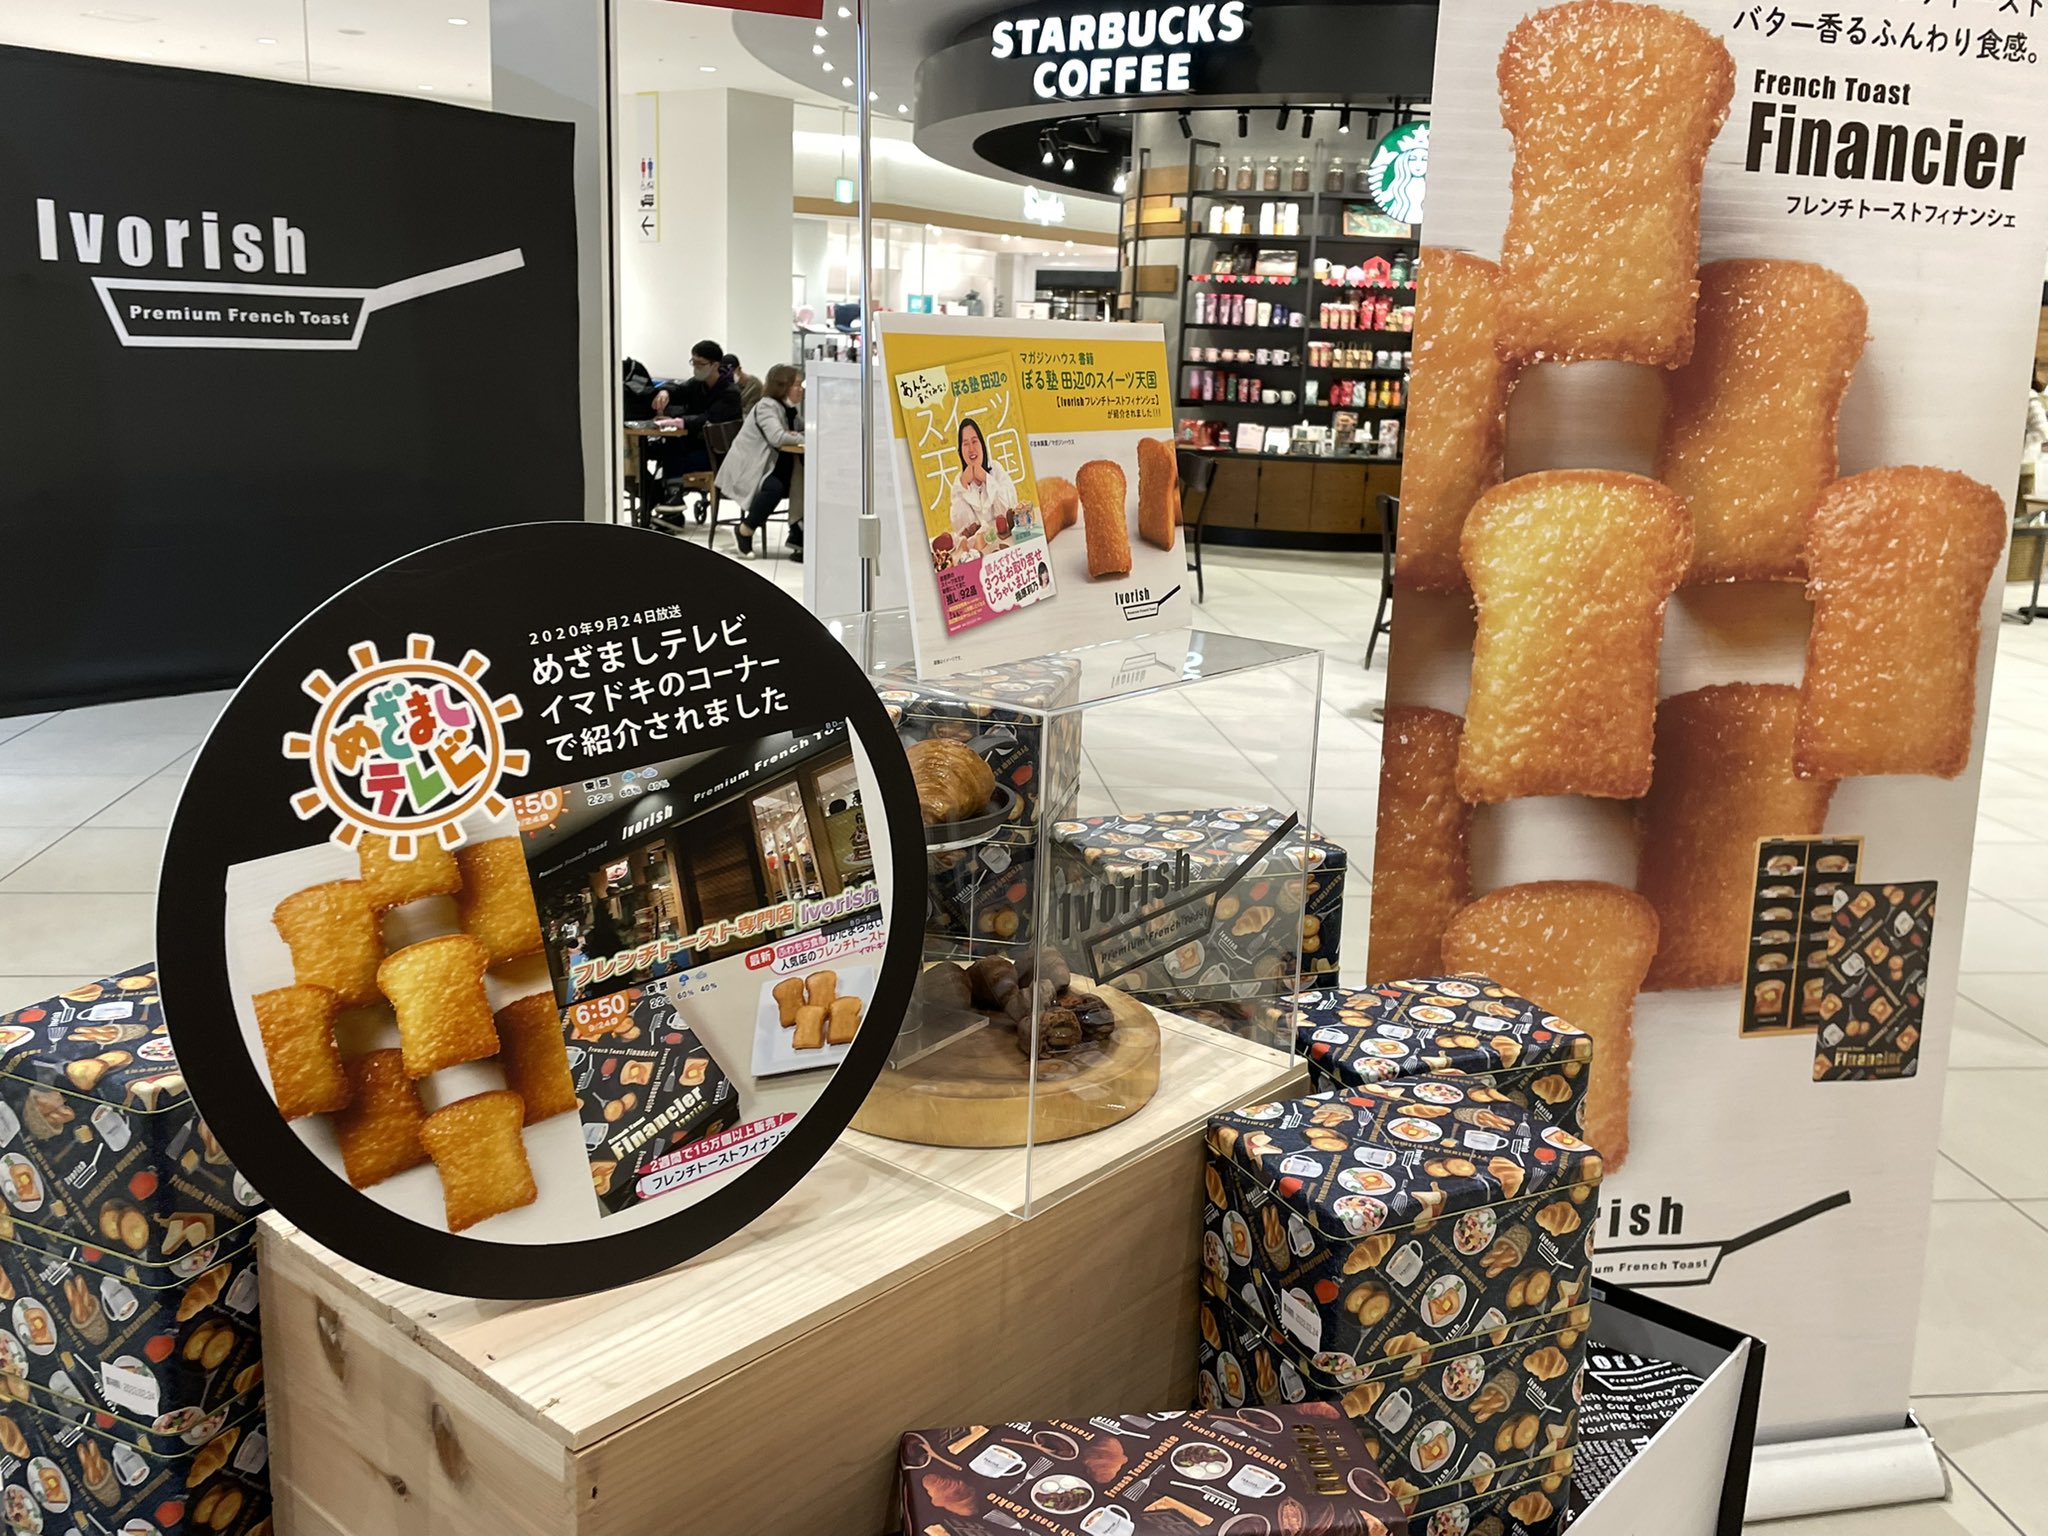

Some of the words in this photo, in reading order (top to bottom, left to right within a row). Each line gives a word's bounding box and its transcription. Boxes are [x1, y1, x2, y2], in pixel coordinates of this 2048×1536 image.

[990, 0, 1247, 59] STARBUCKS
[1733, 6, 2038, 64] バター香るふんわり食感。
[1033, 52, 1193, 99] COFFEE
[1754, 69, 1837, 101] French
[1845, 77, 1912, 106] Toast
[1745, 101, 2027, 191] Financier
[1787, 196, 2017, 228] フレンチトーストフィナンシェ
[36, 197, 307, 276] Ivorish
[129, 304, 222, 324] Premium
[228, 308, 295, 325] French
[299, 310, 350, 326] Toast
[1019, 352, 1077, 365] マガジンハウス
[1114, 587, 1150, 606] Ivorish
[528, 604, 683, 646] 2020年9月24日放送
[532, 613, 748, 686] めざましテレビ
[540, 654, 781, 726] イマドキのコーナー
[546, 686, 789, 763] で紹介されました
[693, 769, 750, 803] Premium
[754, 738, 810, 773] French
[622, 804, 673, 841] Ivorish
[1055, 849, 1190, 941] Ivorish
[573, 902, 795, 986] フレンチトースト専門店
[799, 884, 880, 924] Ivorish
[575, 994, 626, 1026] 6:50
[610, 1087, 704, 1161] Financier
[1597, 1196, 1685, 1238] ish
[1618, 1261, 1668, 1272] French
[1672, 1258, 1708, 1270] Toast
[1144, 1434, 1181, 1462] Cookie
[1183, 1420, 1218, 1440] French
[1217, 1434, 1247, 1451] Toast
[1245, 1445, 1288, 1470] Cookie
[986, 1492, 1031, 1519] Cookie
